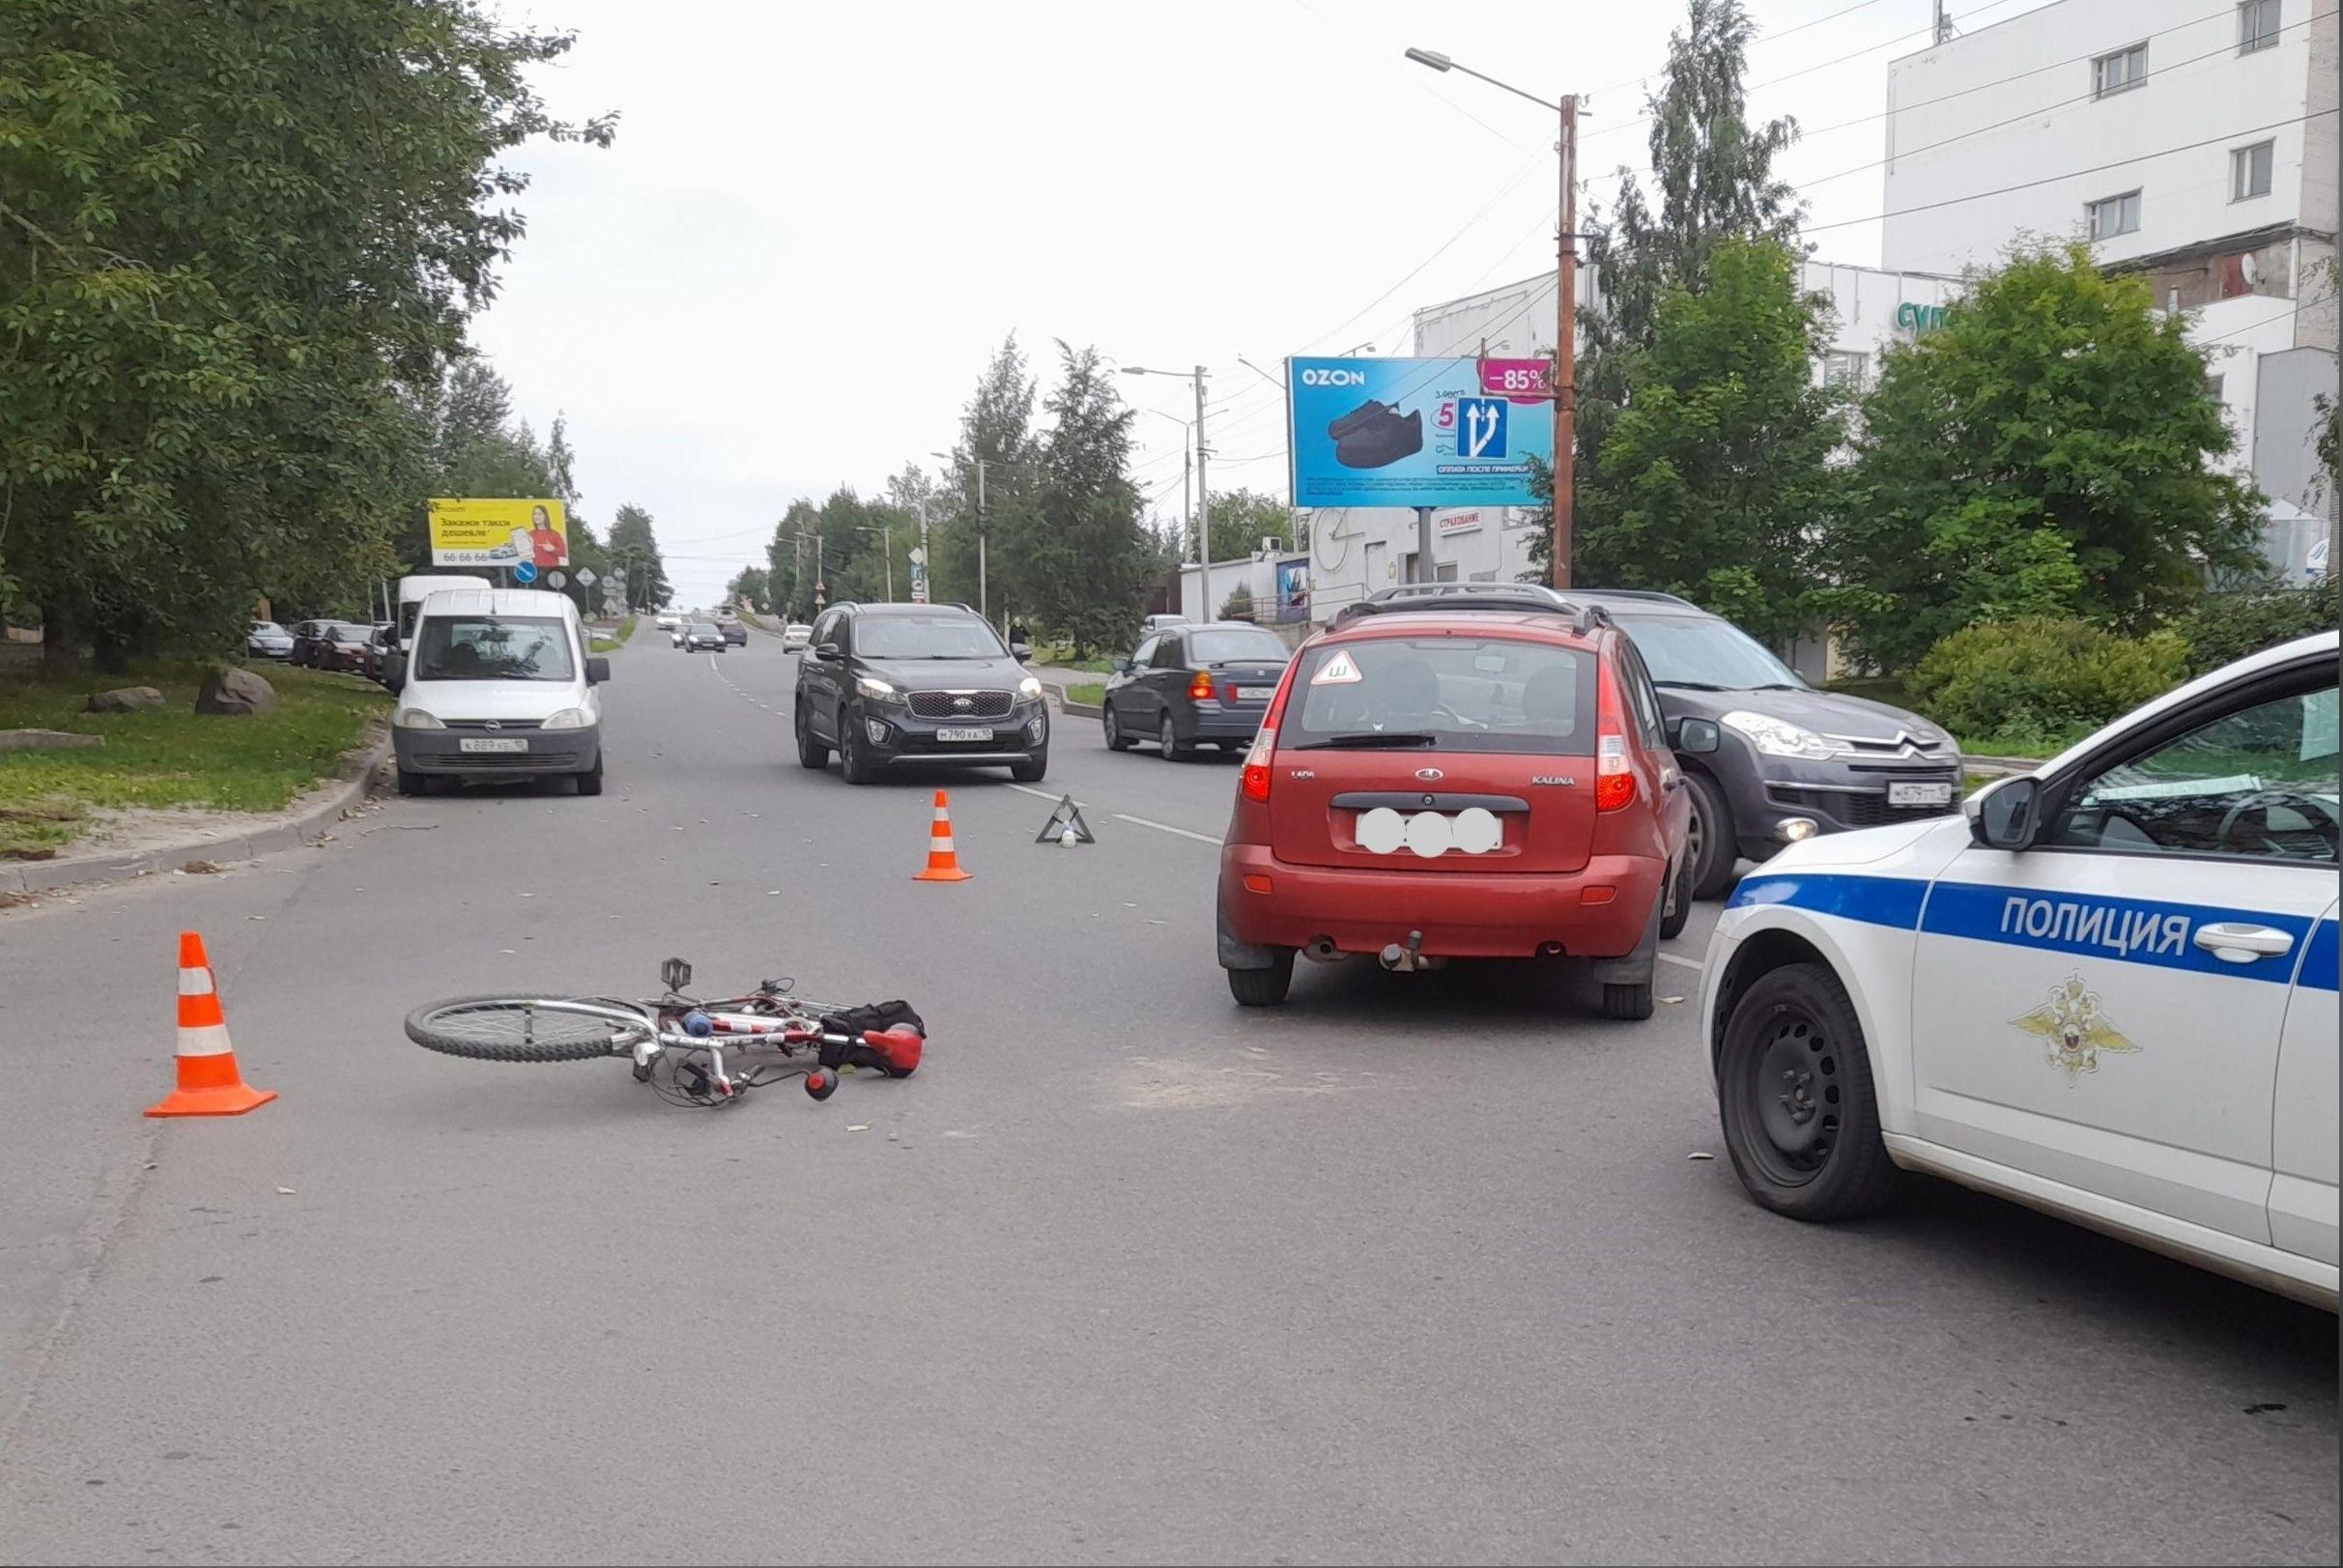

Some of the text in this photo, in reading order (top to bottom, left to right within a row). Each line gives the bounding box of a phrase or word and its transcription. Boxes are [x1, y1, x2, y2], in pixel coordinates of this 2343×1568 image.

[1301, 368, 1365, 386] OZON
[440, 517, 479, 527] Закажи
[1440, 512, 1480, 527] СТРАХОВАНИЕ
[1329, 665, 1348, 678] Ш
[1531, 776, 1575, 785] KALINA
[2001, 897, 2191, 956] ПОЛИЦИЯ
